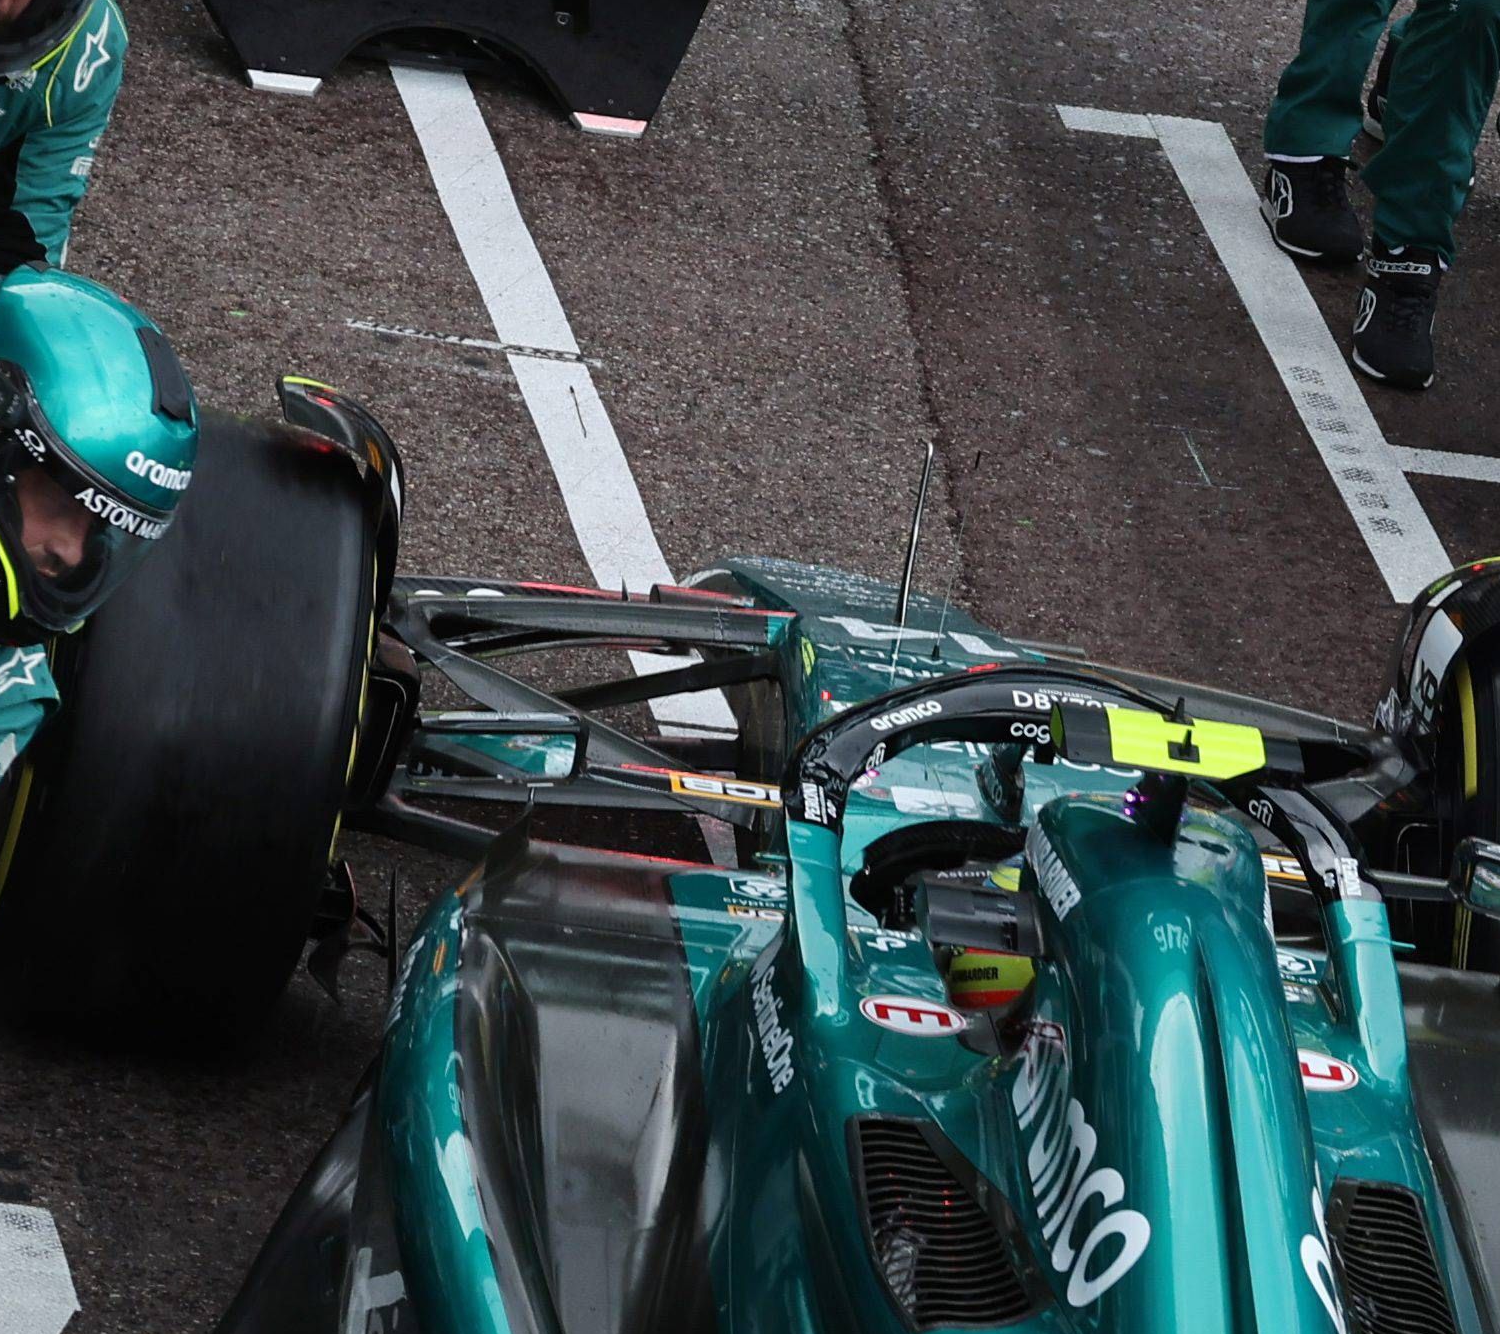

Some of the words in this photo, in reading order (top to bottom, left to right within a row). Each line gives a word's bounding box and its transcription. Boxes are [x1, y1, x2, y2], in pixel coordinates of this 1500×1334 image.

[74, 486, 140, 537] ASTON
[870, 698, 943, 732] aramco
[1248, 798, 1275, 827] citi
[753, 964, 795, 1095] SentinelOne
